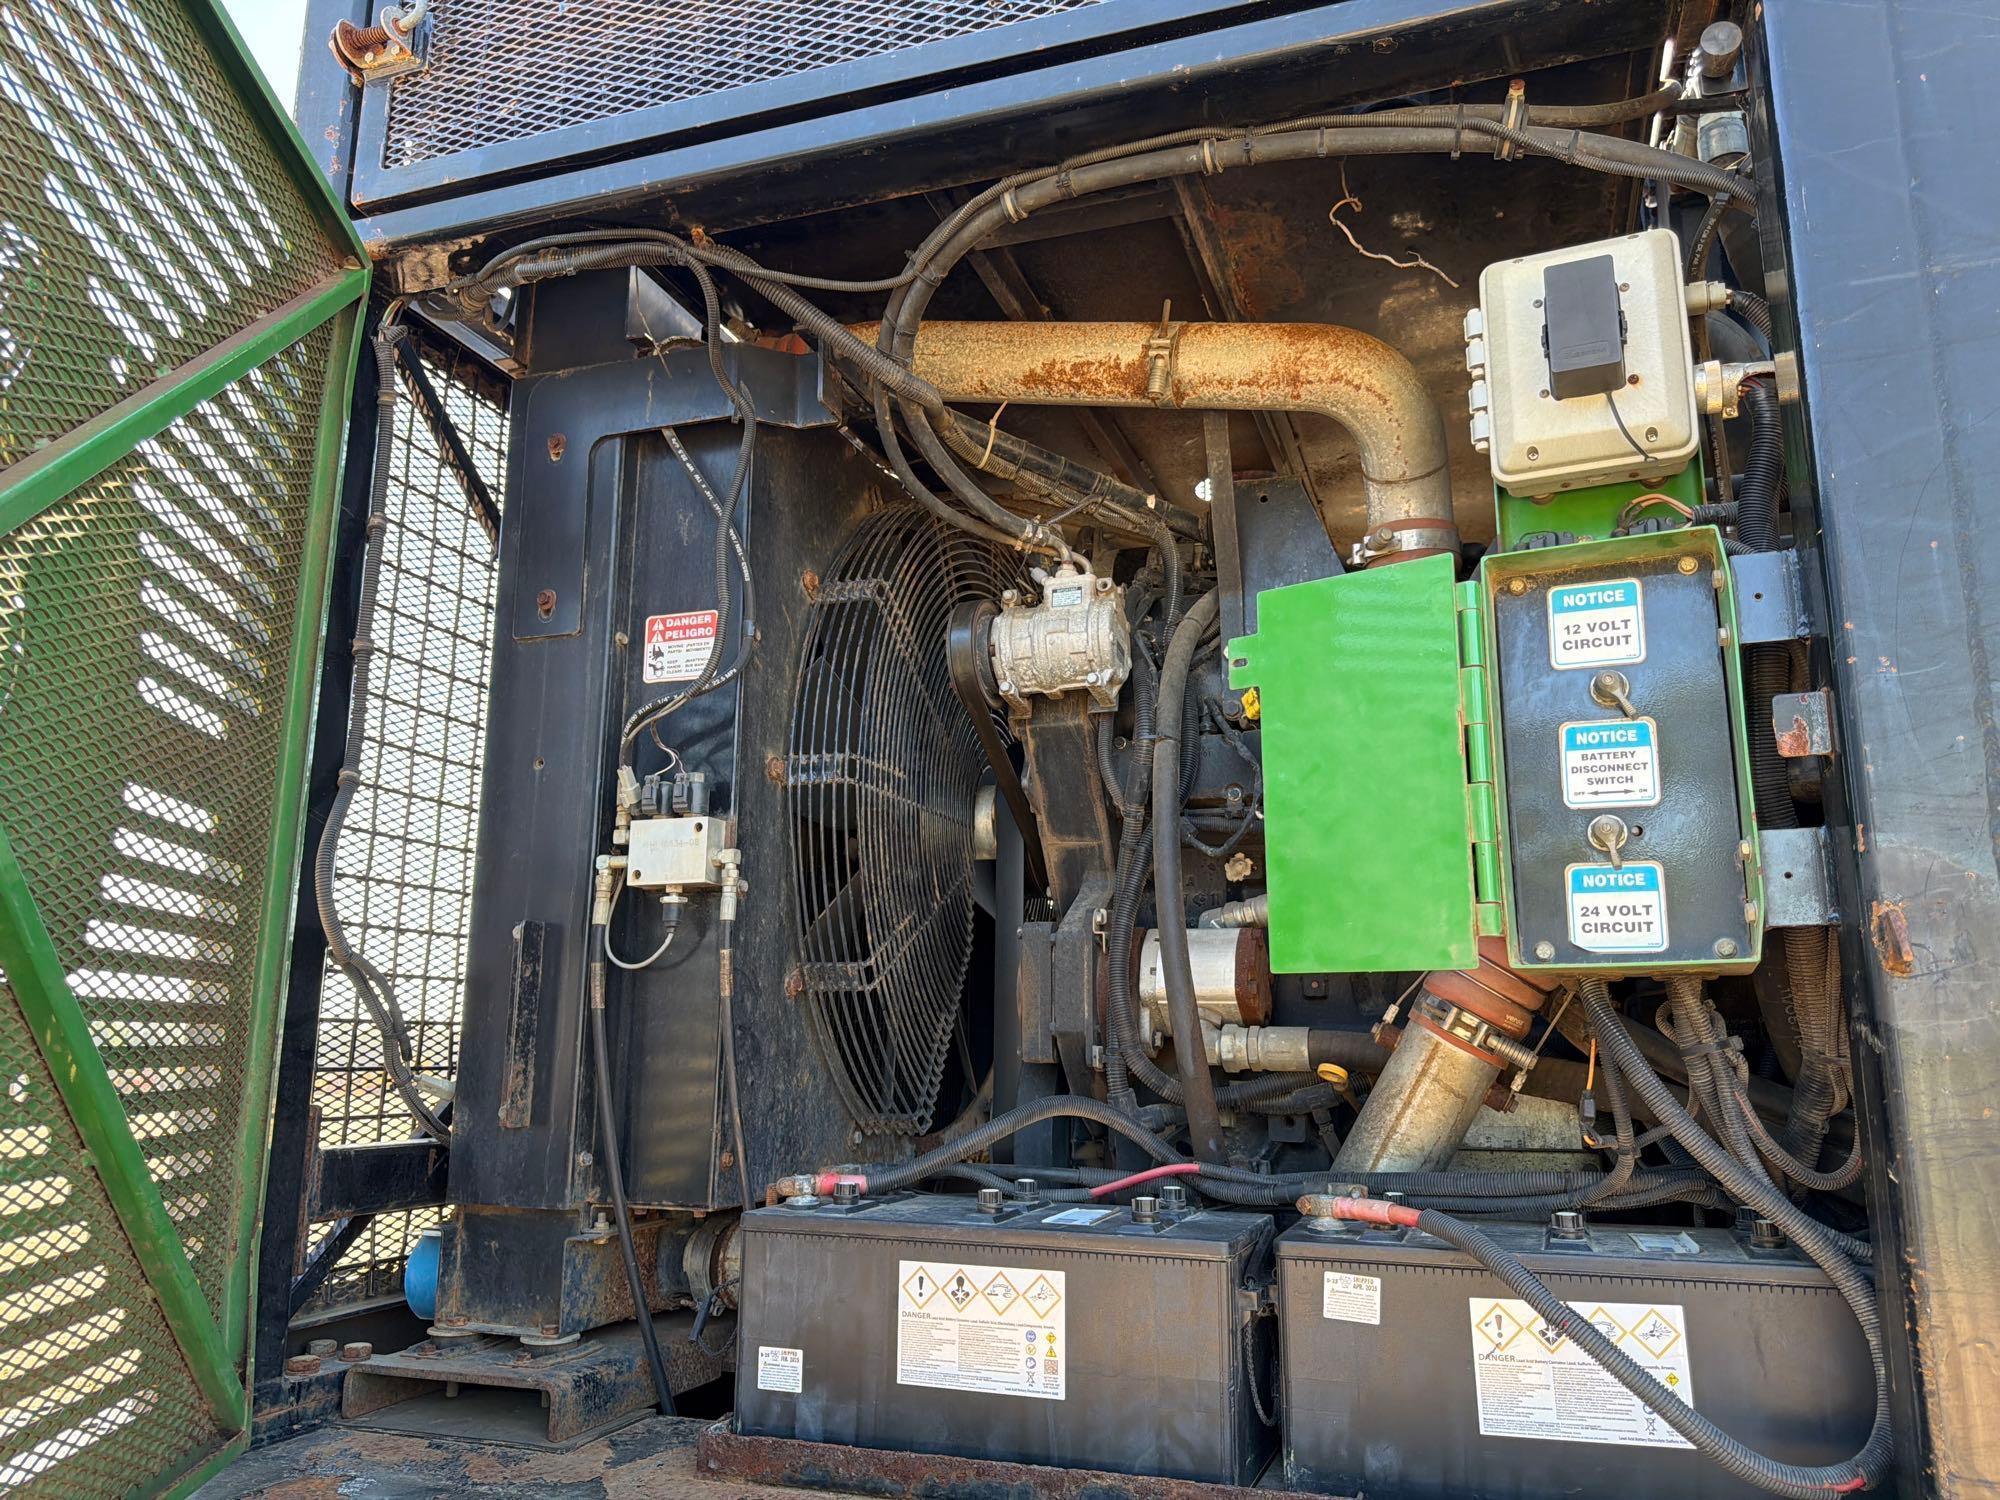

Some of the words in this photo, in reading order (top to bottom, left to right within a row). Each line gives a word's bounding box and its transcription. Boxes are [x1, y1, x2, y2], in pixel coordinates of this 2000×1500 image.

[678, 449, 688, 461] 22.5
[1563, 589, 1625, 607] NOTICE
[666, 614, 712, 627] DANGER
[665, 627, 713, 639] PELIGRO
[1563, 624, 1581, 635] 12
[1587, 619, 1631, 633] VOLT
[1563, 635, 1631, 651] CIRCUIT
[712, 676, 726, 686] 22.5
[1576, 729, 1638, 745] NOTICE
[1581, 750, 1636, 761] BATTERY
[1587, 775, 1634, 786] SWITCH
[1582, 873, 1646, 888] NOTICE
[1581, 906, 1600, 917] 24
[1607, 905, 1653, 916] VOLT
[1581, 922, 1654, 933] CIRCUIT
[901, 1310, 931, 1320] DANGER
[1478, 1353, 1516, 1363] DANGER
